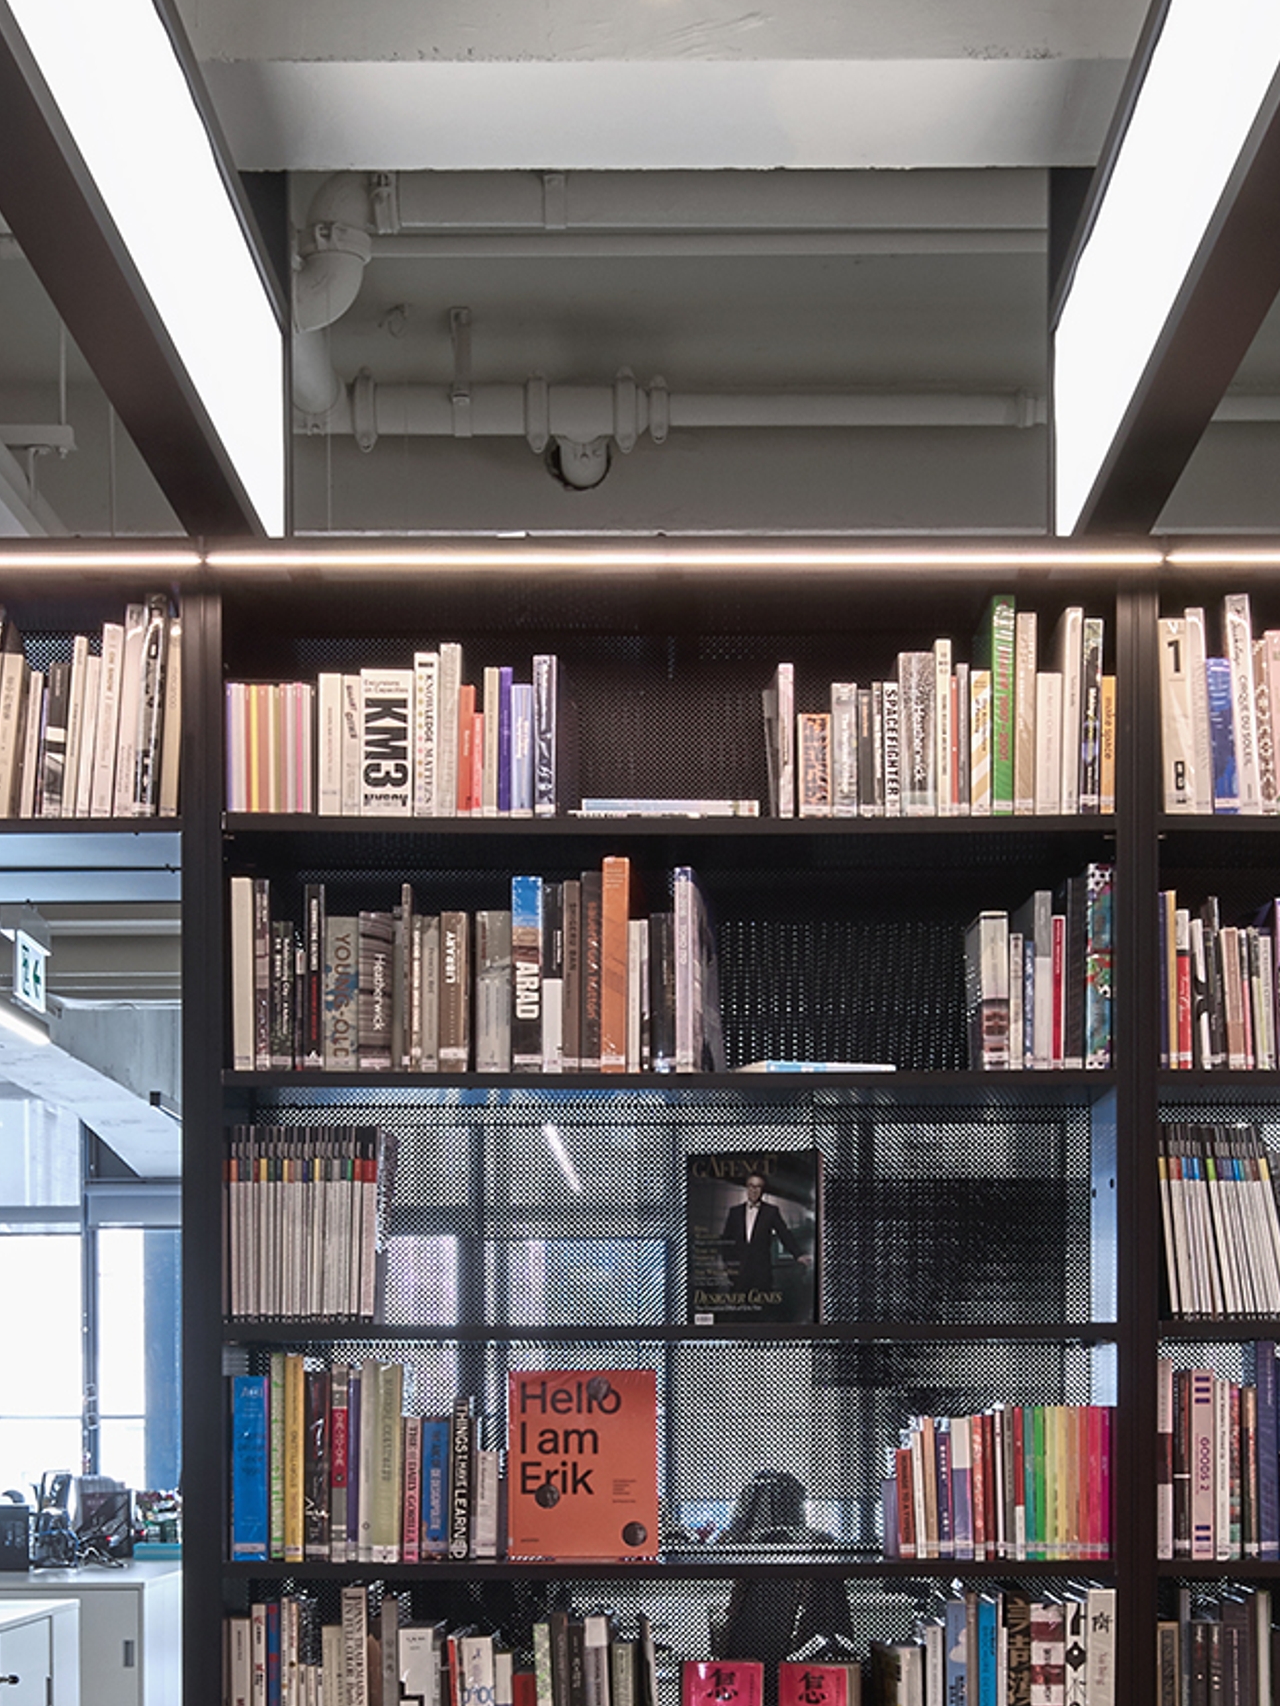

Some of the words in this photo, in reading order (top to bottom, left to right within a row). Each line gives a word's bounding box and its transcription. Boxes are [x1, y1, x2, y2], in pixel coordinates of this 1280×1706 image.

[424, 674, 434, 743] KNOWLEDGE
[1238, 674, 1251, 714] CIRQUE
[364, 697, 409, 788] KM3
[886, 688, 900, 796] SPACEFIGHTER
[1240, 715, 1252, 731] DU
[1242, 732, 1254, 767] SOLEIL
[424, 748, 434, 805] MATTERS
[568, 902, 578, 947] SHIGERU
[446, 930, 457, 985] LIBRARY
[568, 950, 578, 971] BAN
[334, 933, 352, 1057] YOUNG-OLD
[372, 953, 386, 1031] Heatherwick
[515, 961, 540, 1019] ARAD
[693, 1290, 747, 1305] DESIGNER
[748, 1288, 784, 1305] GENES
[405, 1425, 418, 1447] THE
[454, 1403, 468, 1453] THINGS
[520, 1420, 527, 1455] I
[537, 1428, 599, 1455] am
[405, 1460, 418, 1493] DAILY
[454, 1461, 468, 1489] HAVE
[520, 1460, 594, 1495] Erik
[1200, 1436, 1212, 1482] GOODS
[1200, 1483, 1212, 1492] 2
[405, 1494, 418, 1543] GORILLA
[454, 1488, 468, 1559] LEARNED
[343, 1617, 354, 1643] FULL
[982, 1625, 990, 1674] BROCHURE
[343, 1645, 354, 1677] COLOR
[354, 1638, 365, 1706] TRADEMARKS
